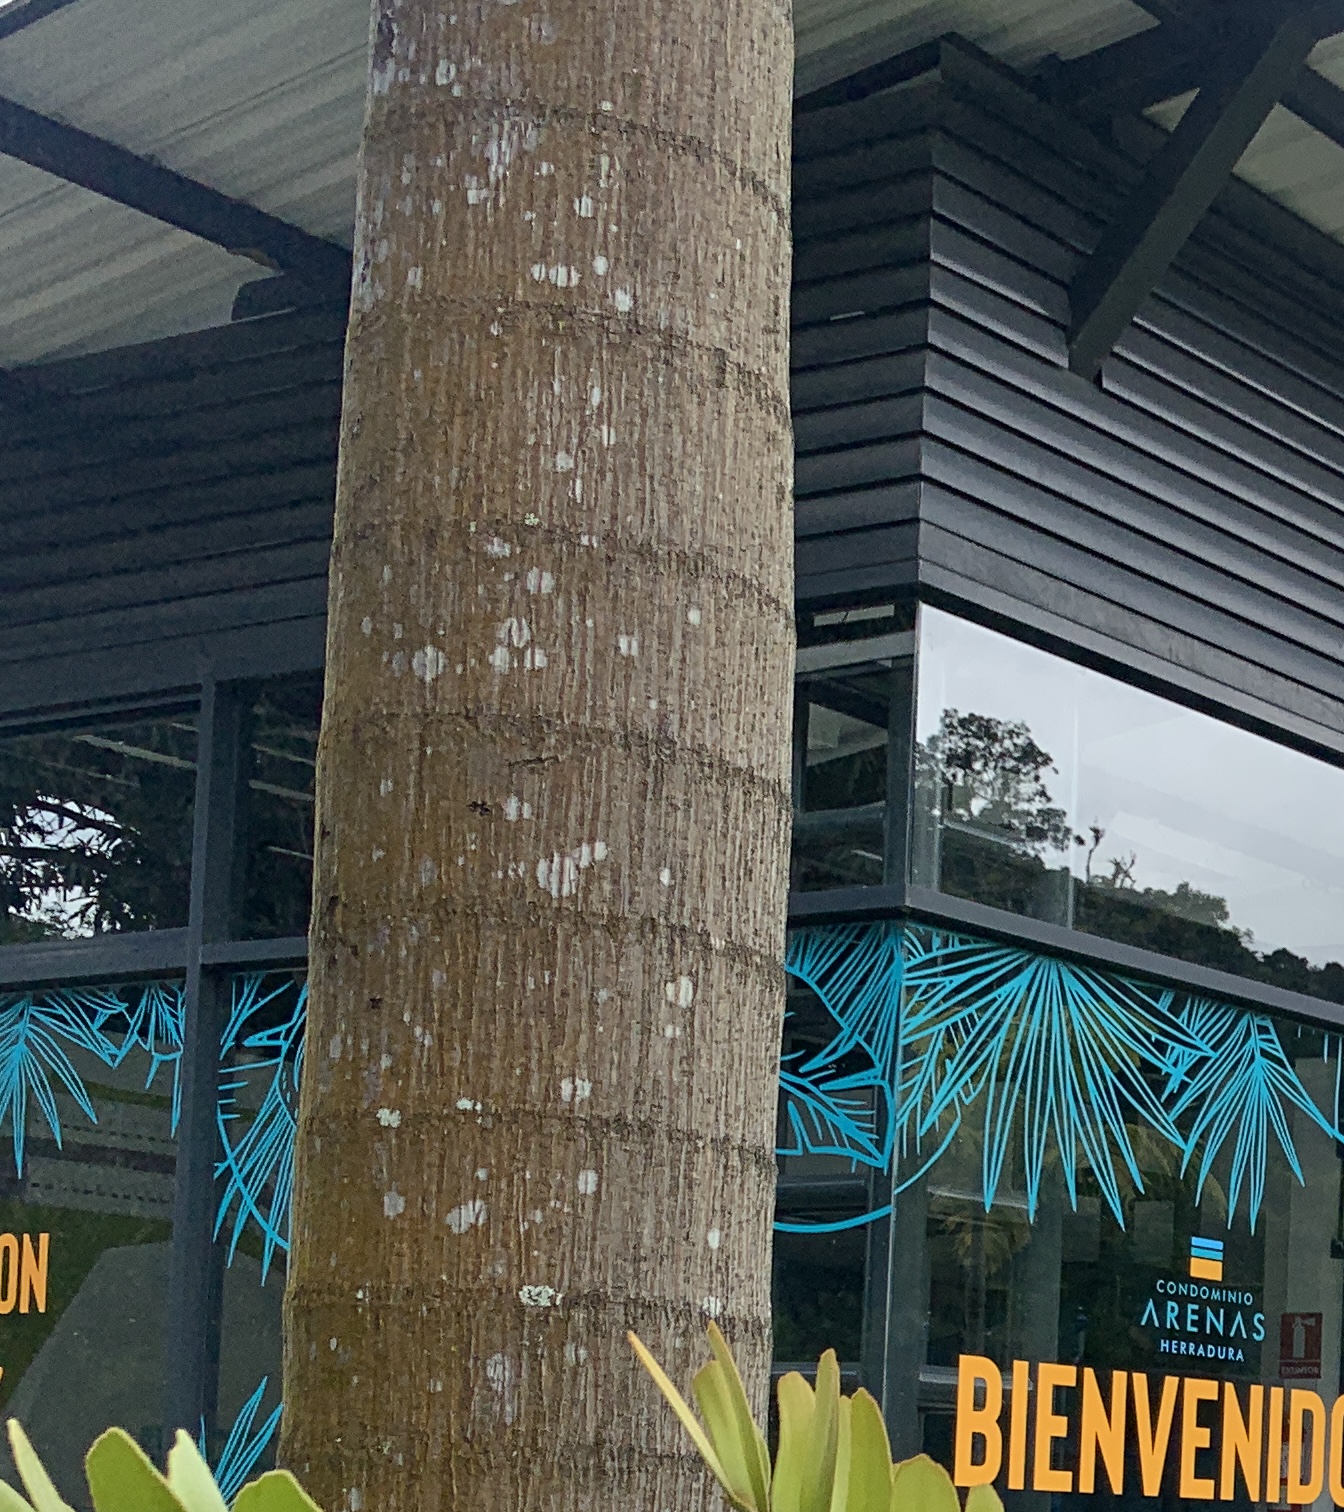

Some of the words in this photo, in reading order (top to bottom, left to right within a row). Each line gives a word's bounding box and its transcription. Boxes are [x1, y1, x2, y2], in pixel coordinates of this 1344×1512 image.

[1156, 1279, 1253, 1306] CONDOMINIO
[1140, 1298, 1266, 1341] ARENAS
[1160, 1339, 1244, 1362] HERRADURA
